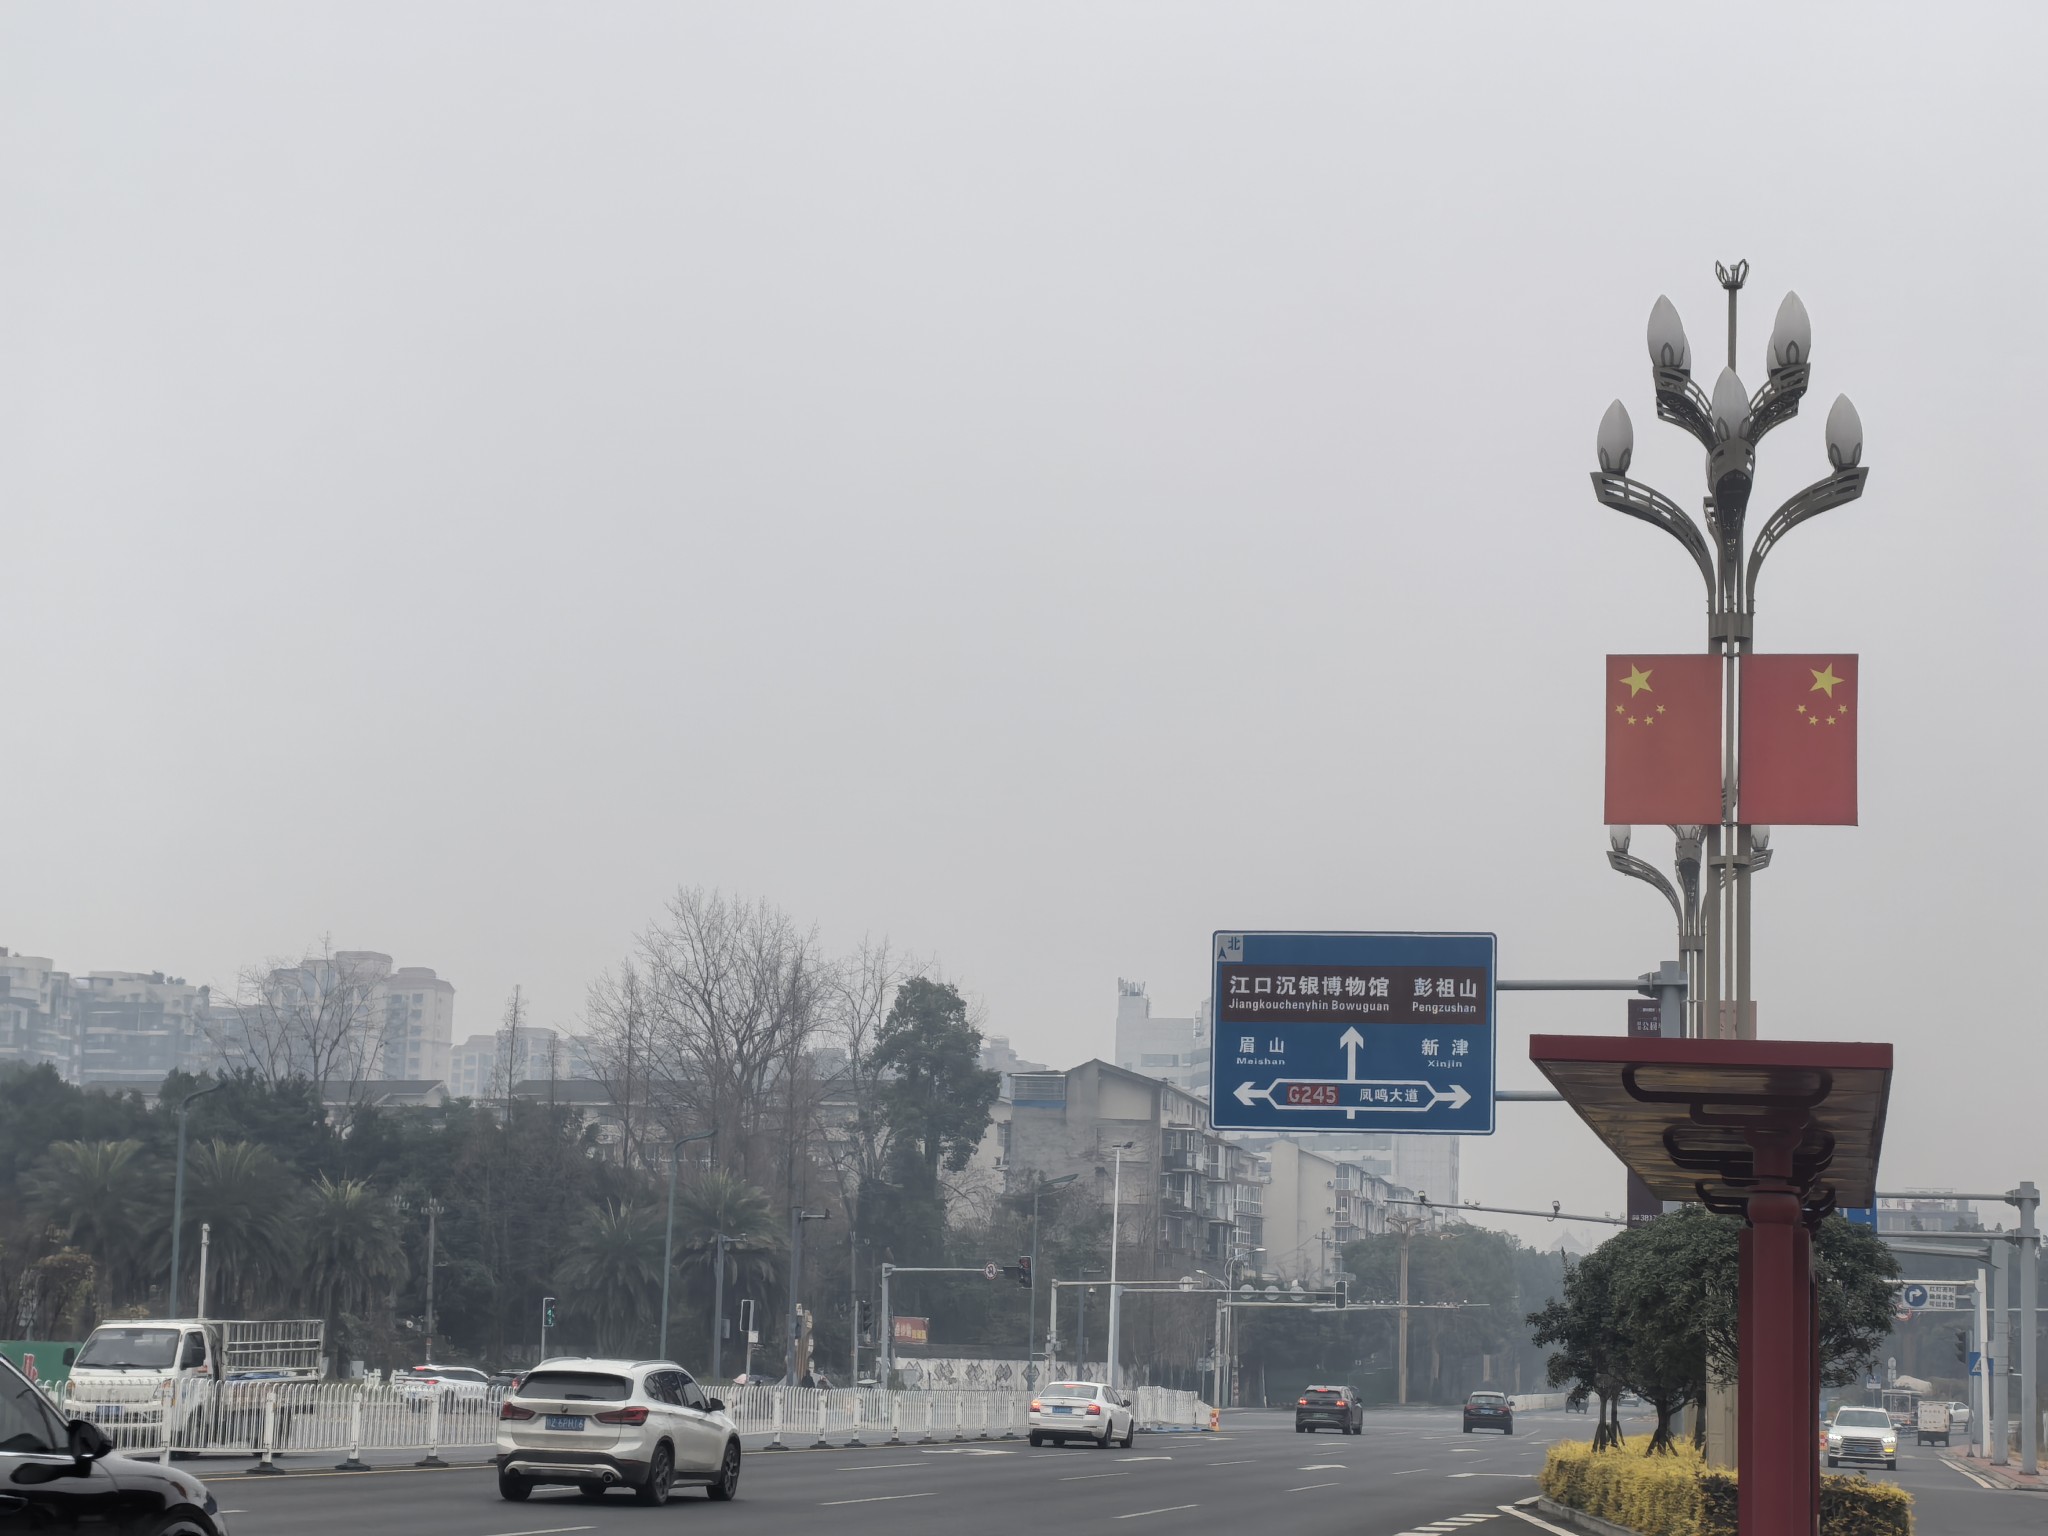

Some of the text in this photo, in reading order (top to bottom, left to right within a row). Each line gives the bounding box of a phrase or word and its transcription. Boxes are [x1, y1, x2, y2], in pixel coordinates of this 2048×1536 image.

[1228, 936, 1240, 950] 北
[1229, 975, 1390, 997] 江口沉银博物馆
[1413, 977, 1477, 997] 彭祖山
[1228, 998, 1389, 1013] Jiangkouchenyhin Bowuguan
[1412, 1001, 1477, 1014] Pengzushan
[1239, 1036, 1284, 1053] 眉山
[1421, 1038, 1469, 1056] 新津
[1236, 1057, 1286, 1065] Meishan
[1428, 1060, 1463, 1068] Xinjin
[1289, 1086, 1337, 1104] G245
[1360, 1088, 1419, 1103] 凤鸣大道
